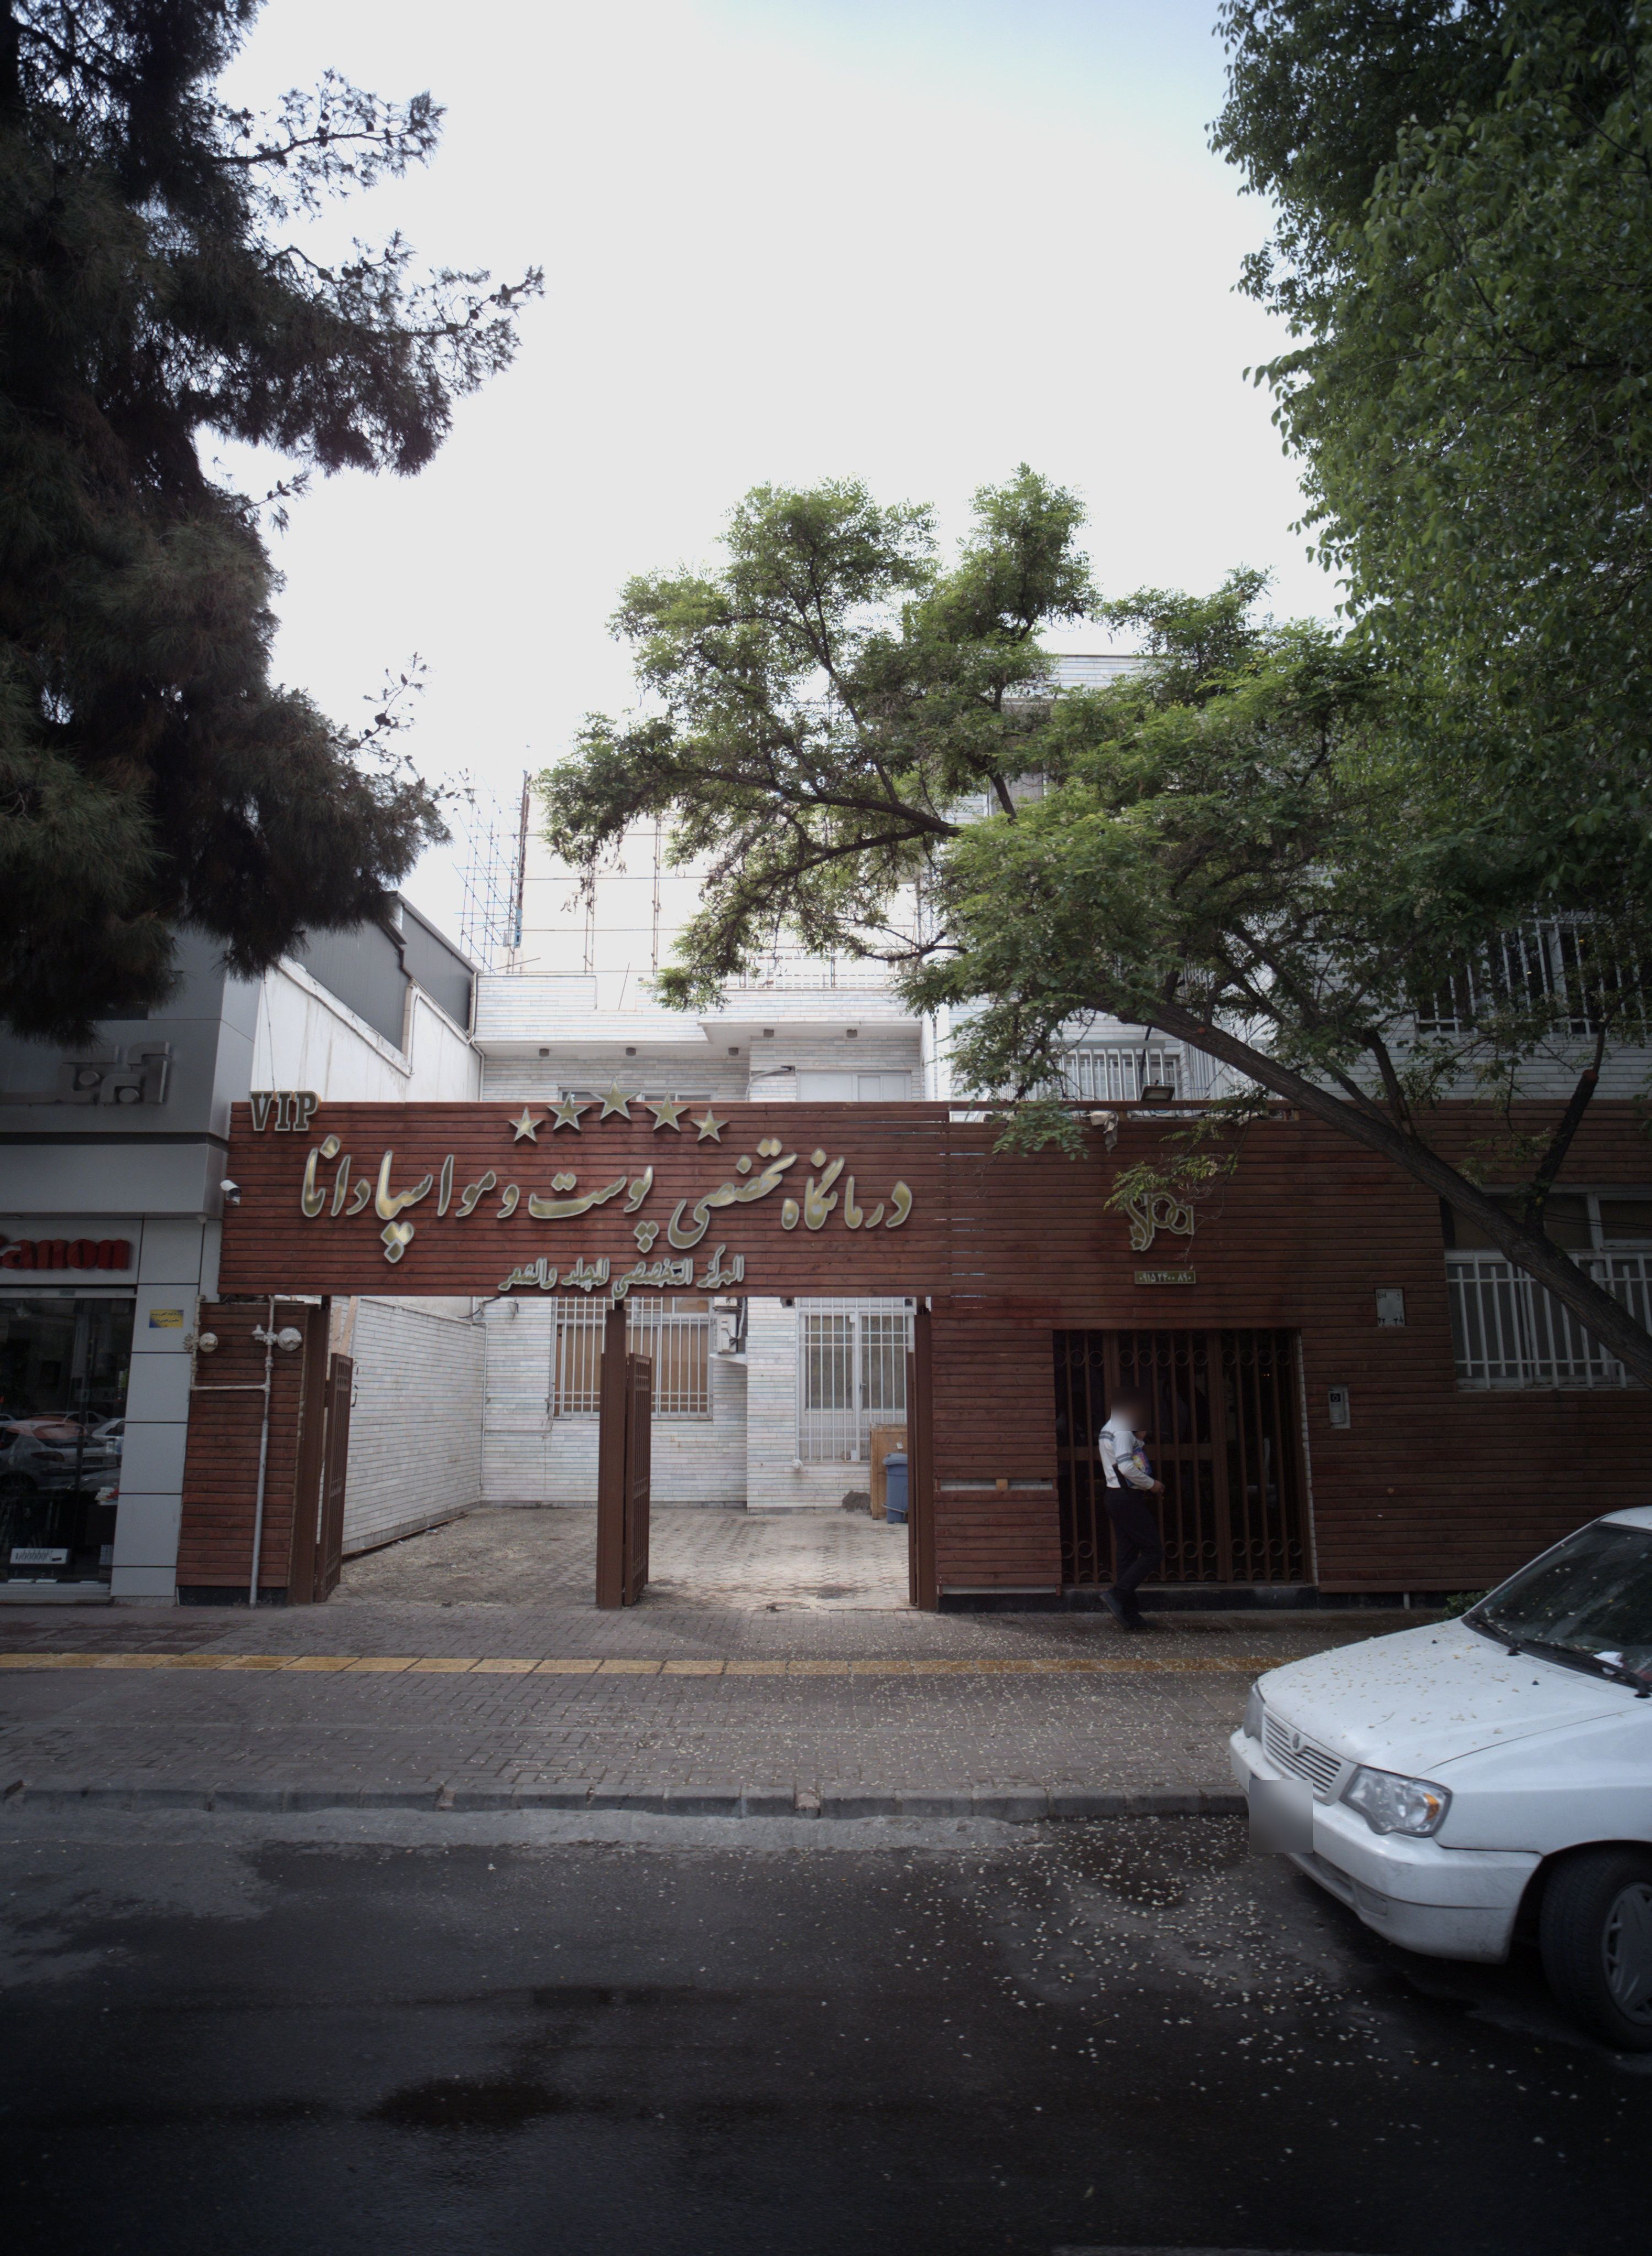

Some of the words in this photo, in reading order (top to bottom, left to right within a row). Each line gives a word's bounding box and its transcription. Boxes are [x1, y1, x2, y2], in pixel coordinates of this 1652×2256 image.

[249, 1091, 319, 1131] VIP
[301, 1135, 454, 1263] اسپادانا
[528, 1166, 659, 1253] پوست
[668, 1138, 797, 1249] تخصصی
[781, 1148, 912, 1230] درمانگاه
[0, 1234, 130, 1269] anon
